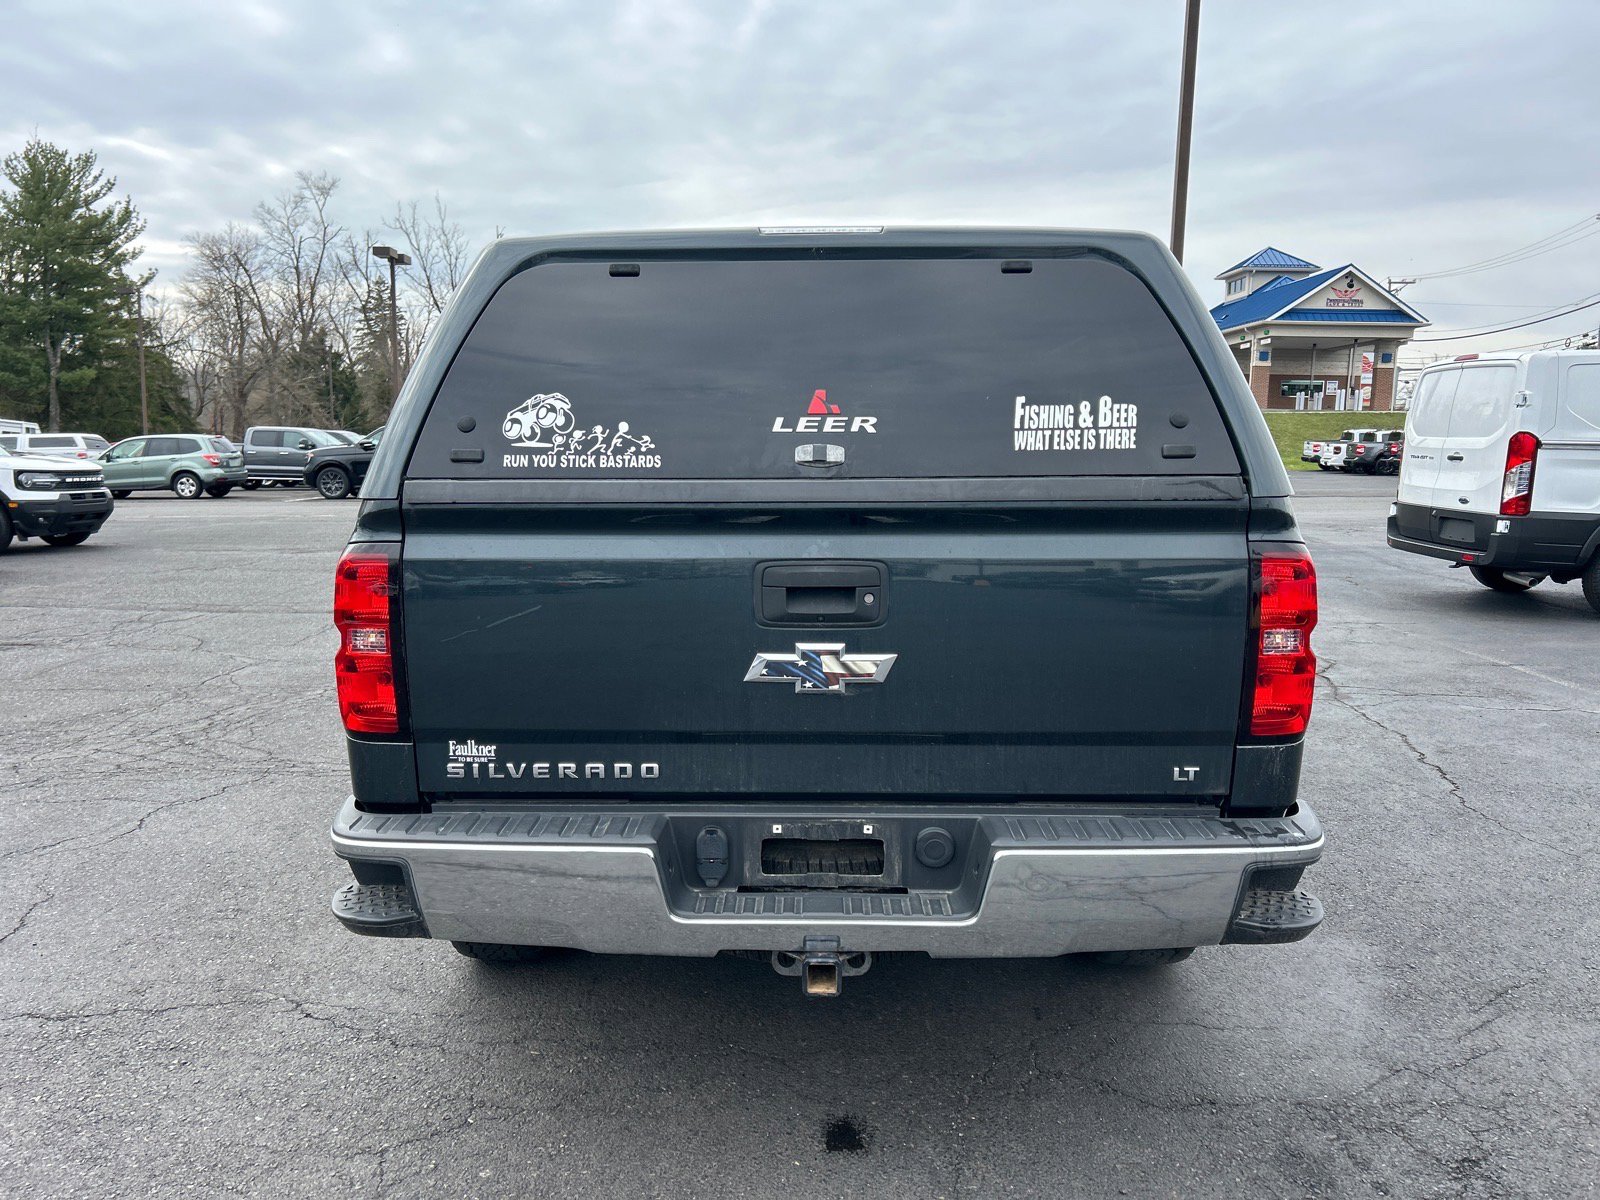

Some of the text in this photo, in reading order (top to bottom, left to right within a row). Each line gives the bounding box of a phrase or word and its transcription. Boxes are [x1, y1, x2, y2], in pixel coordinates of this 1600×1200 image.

[1078, 400, 1094, 428] &
[772, 416, 878, 433] LEER
[1014, 428, 1137, 451] WHAT ELSE IS THERE
[503, 454, 662, 468] RUN YOU STICK BASTARDS
[448, 740, 496, 756] Faulkner
[446, 763, 660, 779] SILVERADO
[1173, 767, 1200, 781] LT
